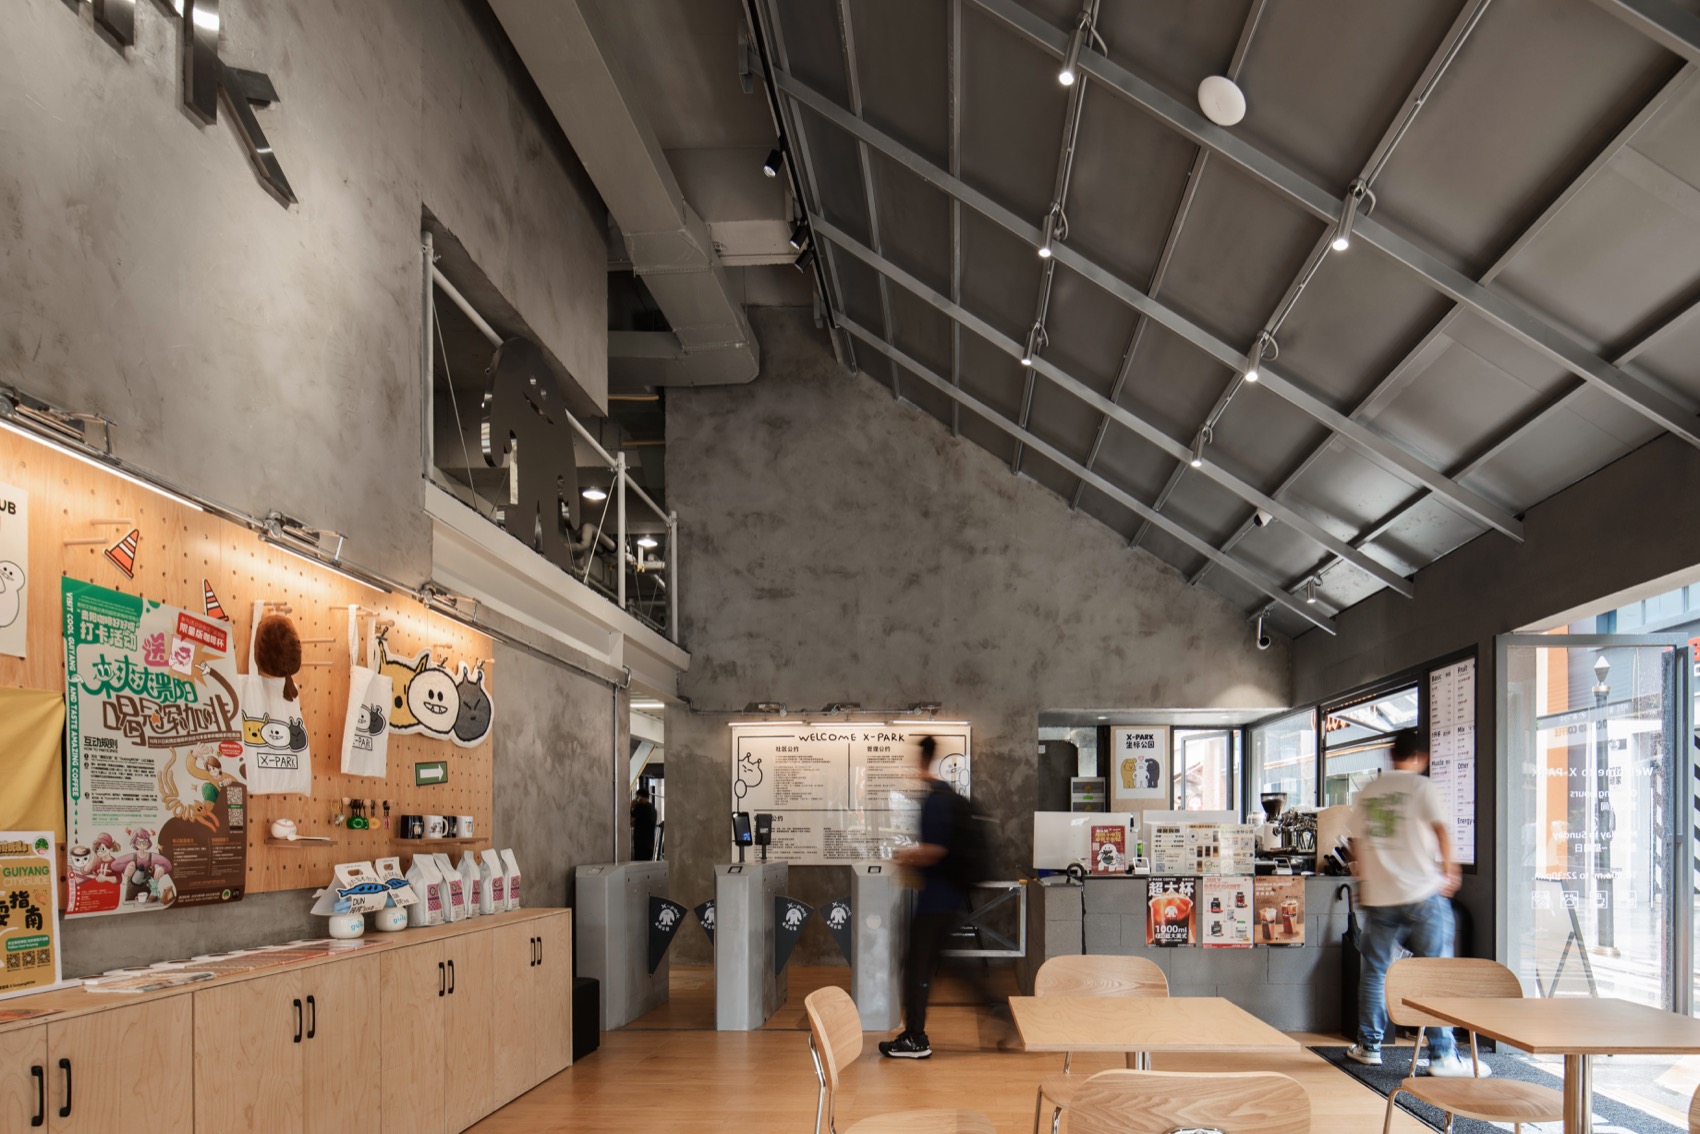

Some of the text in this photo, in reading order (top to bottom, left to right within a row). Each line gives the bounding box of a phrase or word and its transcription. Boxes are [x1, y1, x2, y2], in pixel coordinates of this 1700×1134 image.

[66, 592, 77, 672] VISIT COOL GUIYANG
[80, 620, 137, 652] 打卡活动
[1458, 664, 1468, 674] Fruit
[1432, 674, 1442, 682] Basic
[70, 685, 78, 703] AND
[799, 732, 905, 742] WELCOME X-PARK
[83, 735, 118, 750] 互动规则
[1126, 741, 1155, 749] 坐标公园
[71, 730, 79, 767] AMAZING
[260, 755, 296, 768] X-PARK
[1458, 762, 1469, 770] Other
[1458, 817, 1472, 826] Energy
[3, 866, 49, 877] GUIYANG
[1149, 881, 1194, 897] 超大杯
[353, 897, 366, 906] DUN
[1155, 925, 1188, 933] 1000ml
